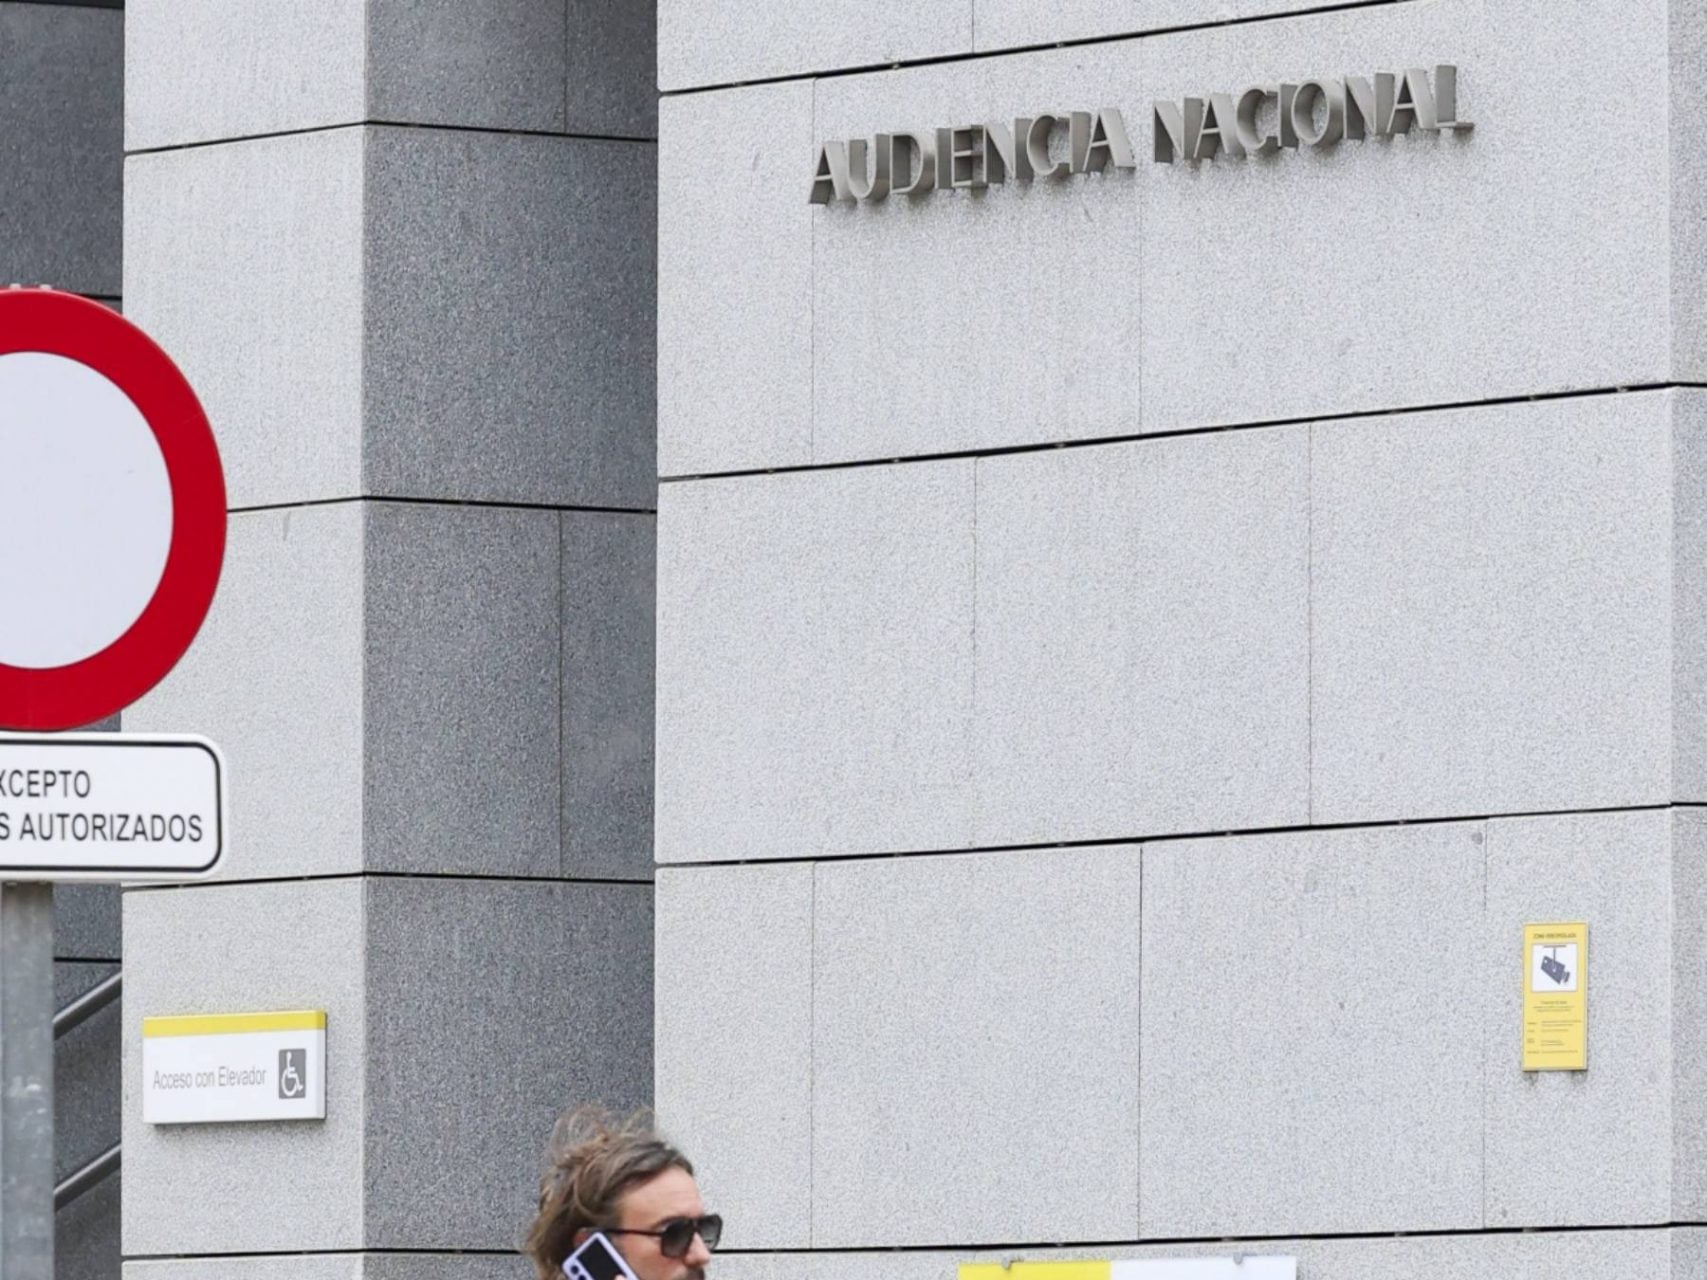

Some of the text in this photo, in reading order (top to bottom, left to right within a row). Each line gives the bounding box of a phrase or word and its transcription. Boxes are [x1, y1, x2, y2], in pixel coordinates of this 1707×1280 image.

[811, 65, 1474, 204] AUDIENCIA NACIONAL
[19, 813, 203, 842] AUTORIZADOS
[153, 1065, 267, 1089] Acceso con Elevador
